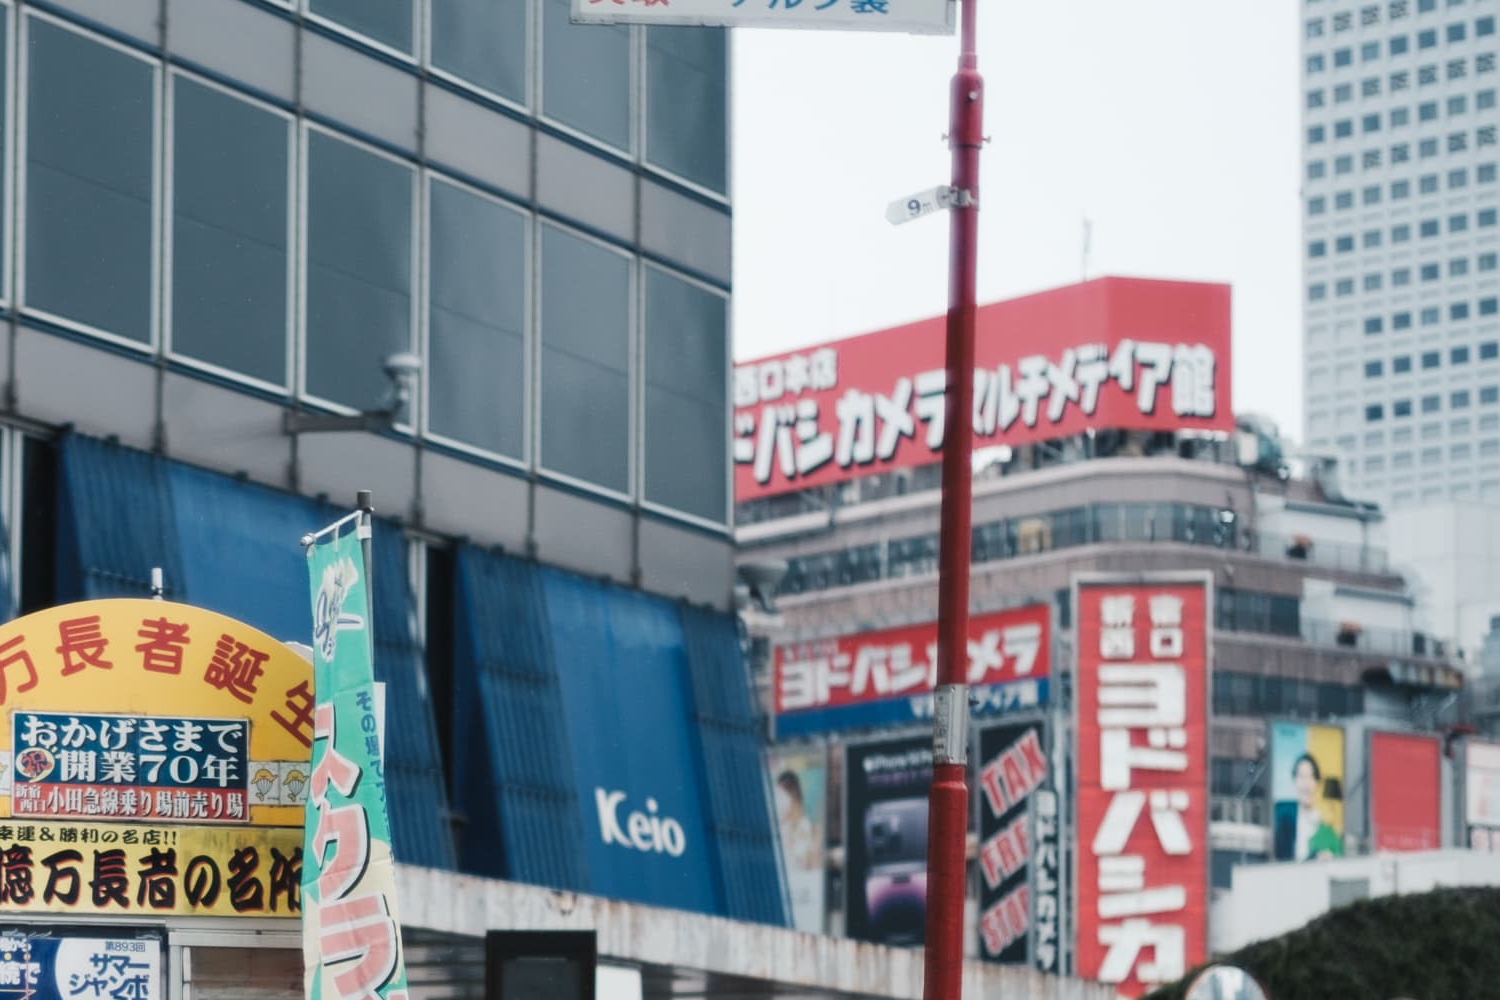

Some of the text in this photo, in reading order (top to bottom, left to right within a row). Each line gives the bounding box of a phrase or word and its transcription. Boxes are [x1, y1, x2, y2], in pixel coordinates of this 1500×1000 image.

[780, 624, 1042, 710] ヨドバシメラ
[20, 715, 243, 754] おかげさまで
[60, 750, 240, 788] 開業70年
[980, 728, 1047, 818] TAX
[49, 785, 244, 820] 小田急線乗り場前売り場
[595, 787, 686, 857] Keio
[1091, 664, 1192, 985] ヨドバシカ
[980, 812, 1030, 891] FRE
[90, 953, 150, 975] サマー
[105, 941, 146, 952] 第893回
